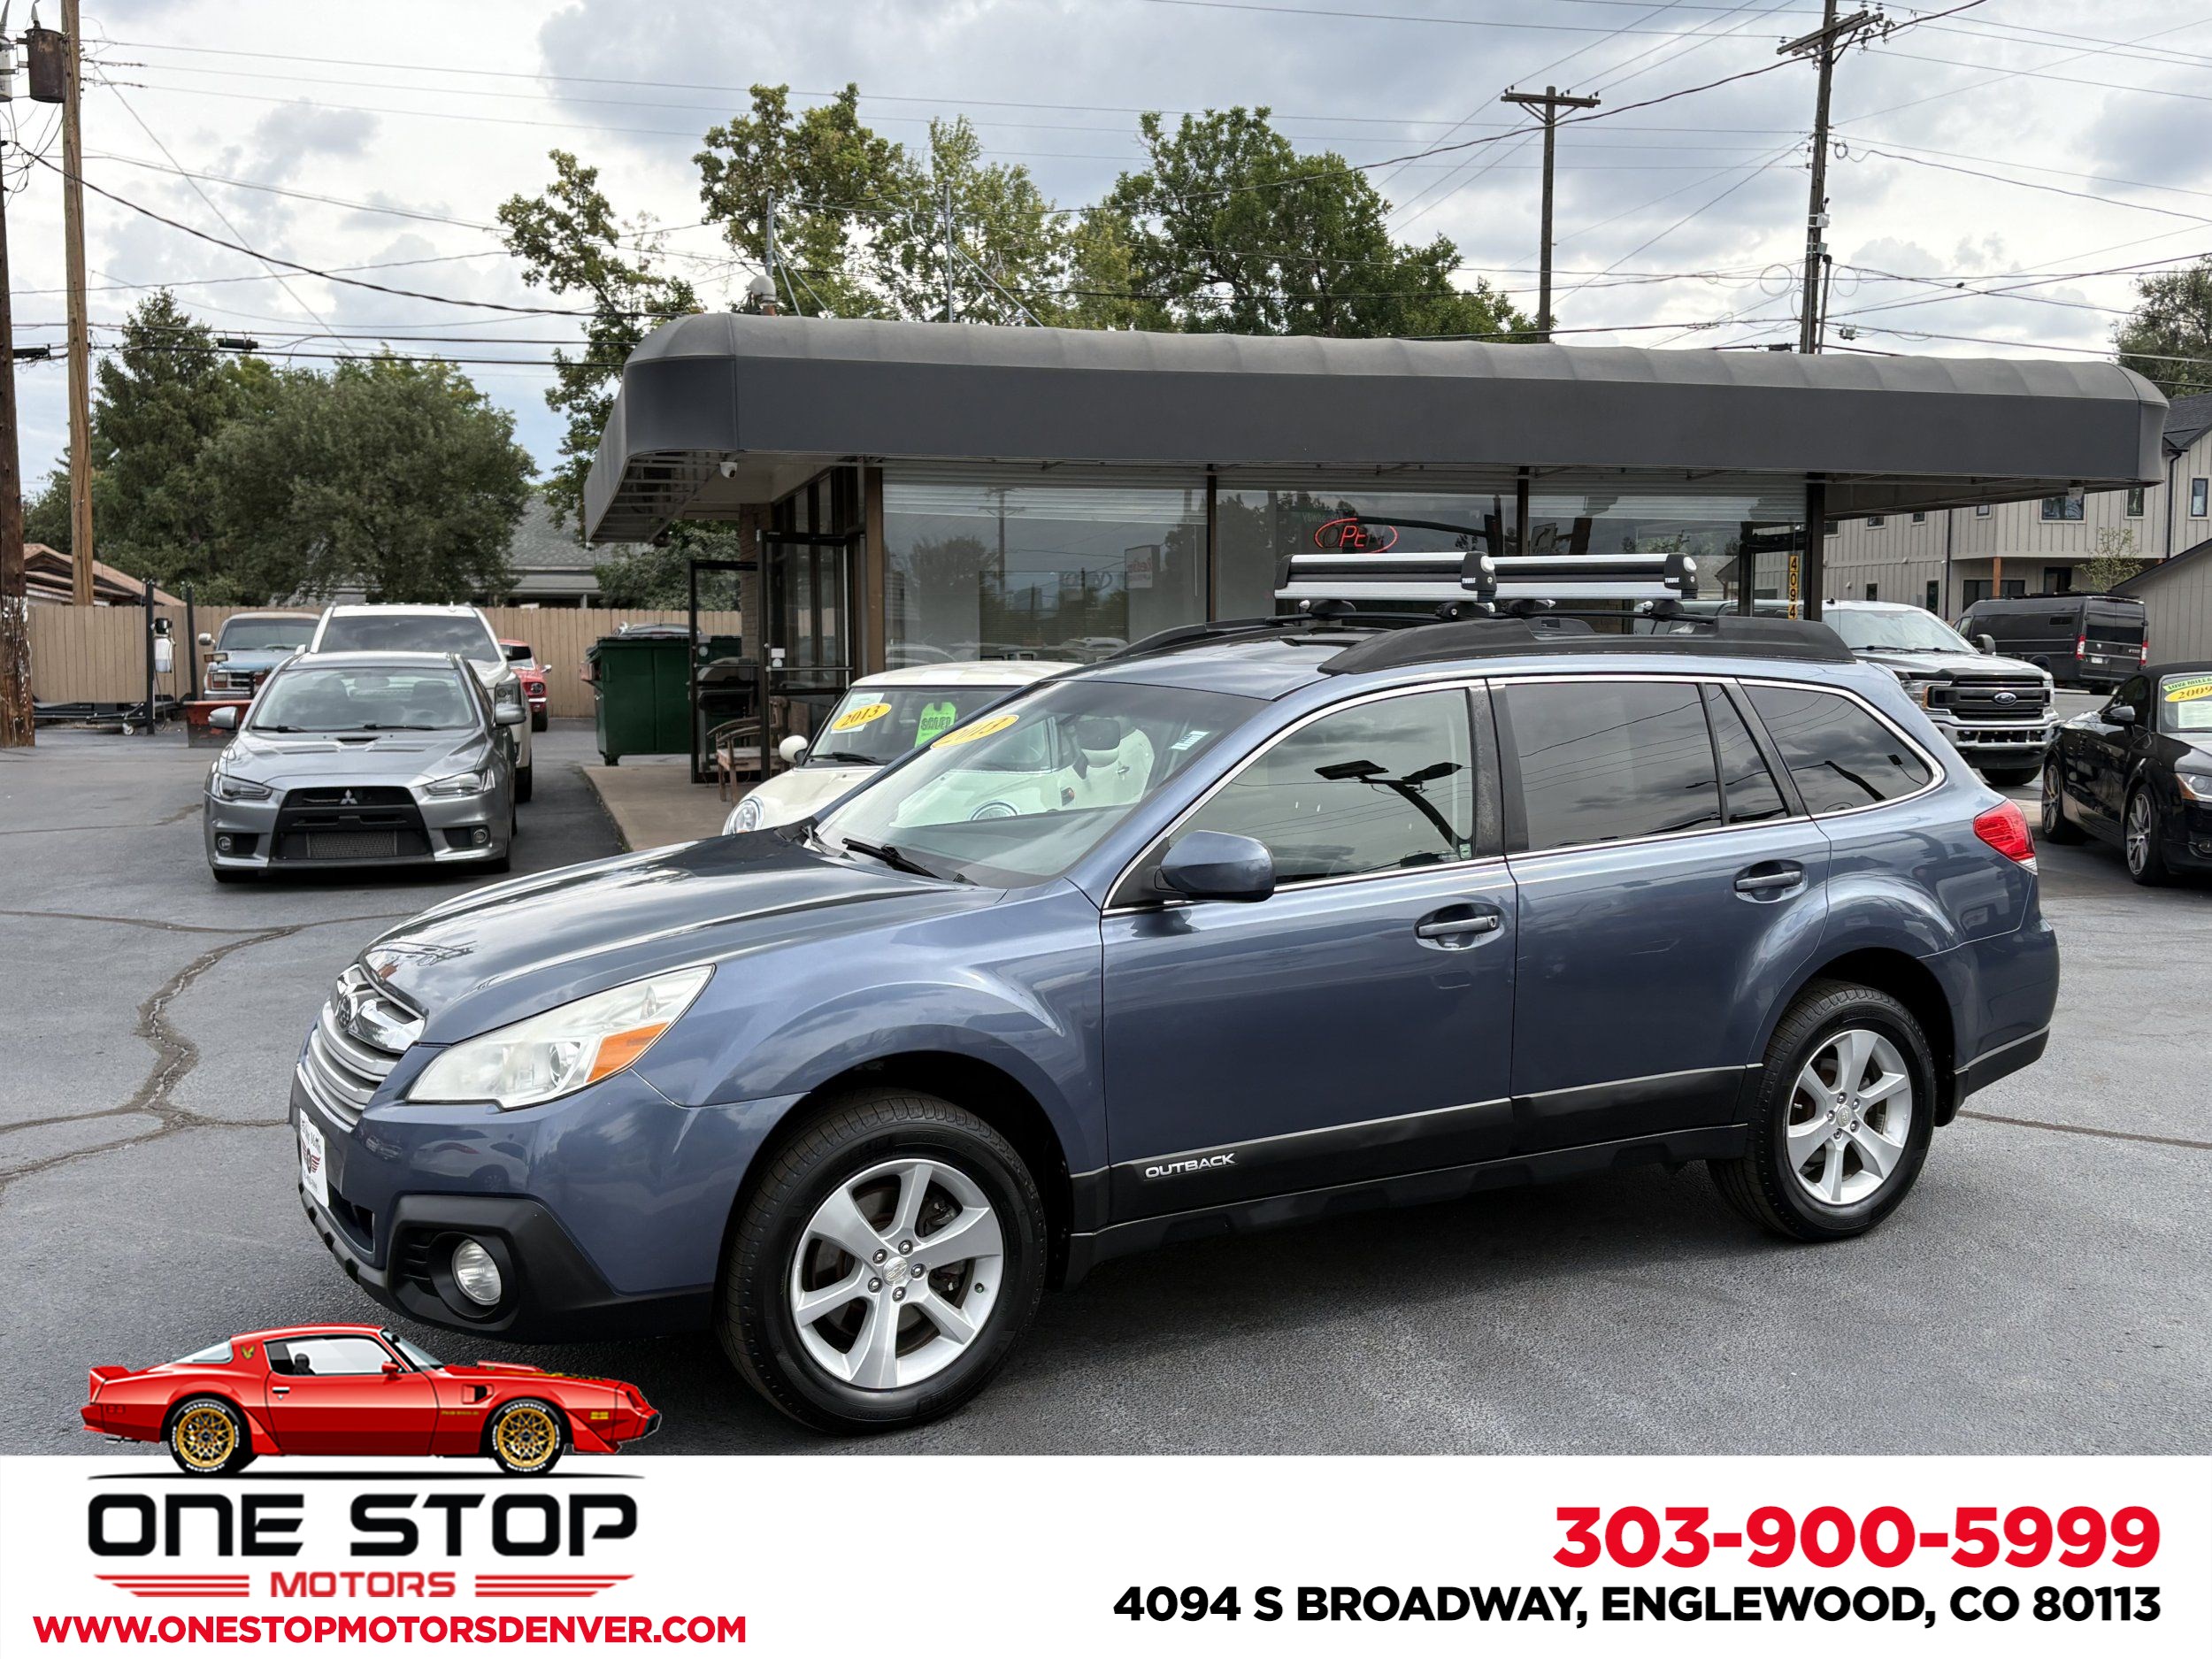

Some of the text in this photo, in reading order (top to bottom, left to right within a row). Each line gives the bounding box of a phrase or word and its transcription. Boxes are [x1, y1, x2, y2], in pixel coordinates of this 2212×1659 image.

[1789, 556, 1798, 618] 4094
[2177, 685, 2212, 700] 2009
[840, 705, 881, 727] 2013
[1145, 1152, 1236, 1179] OUTBACK
